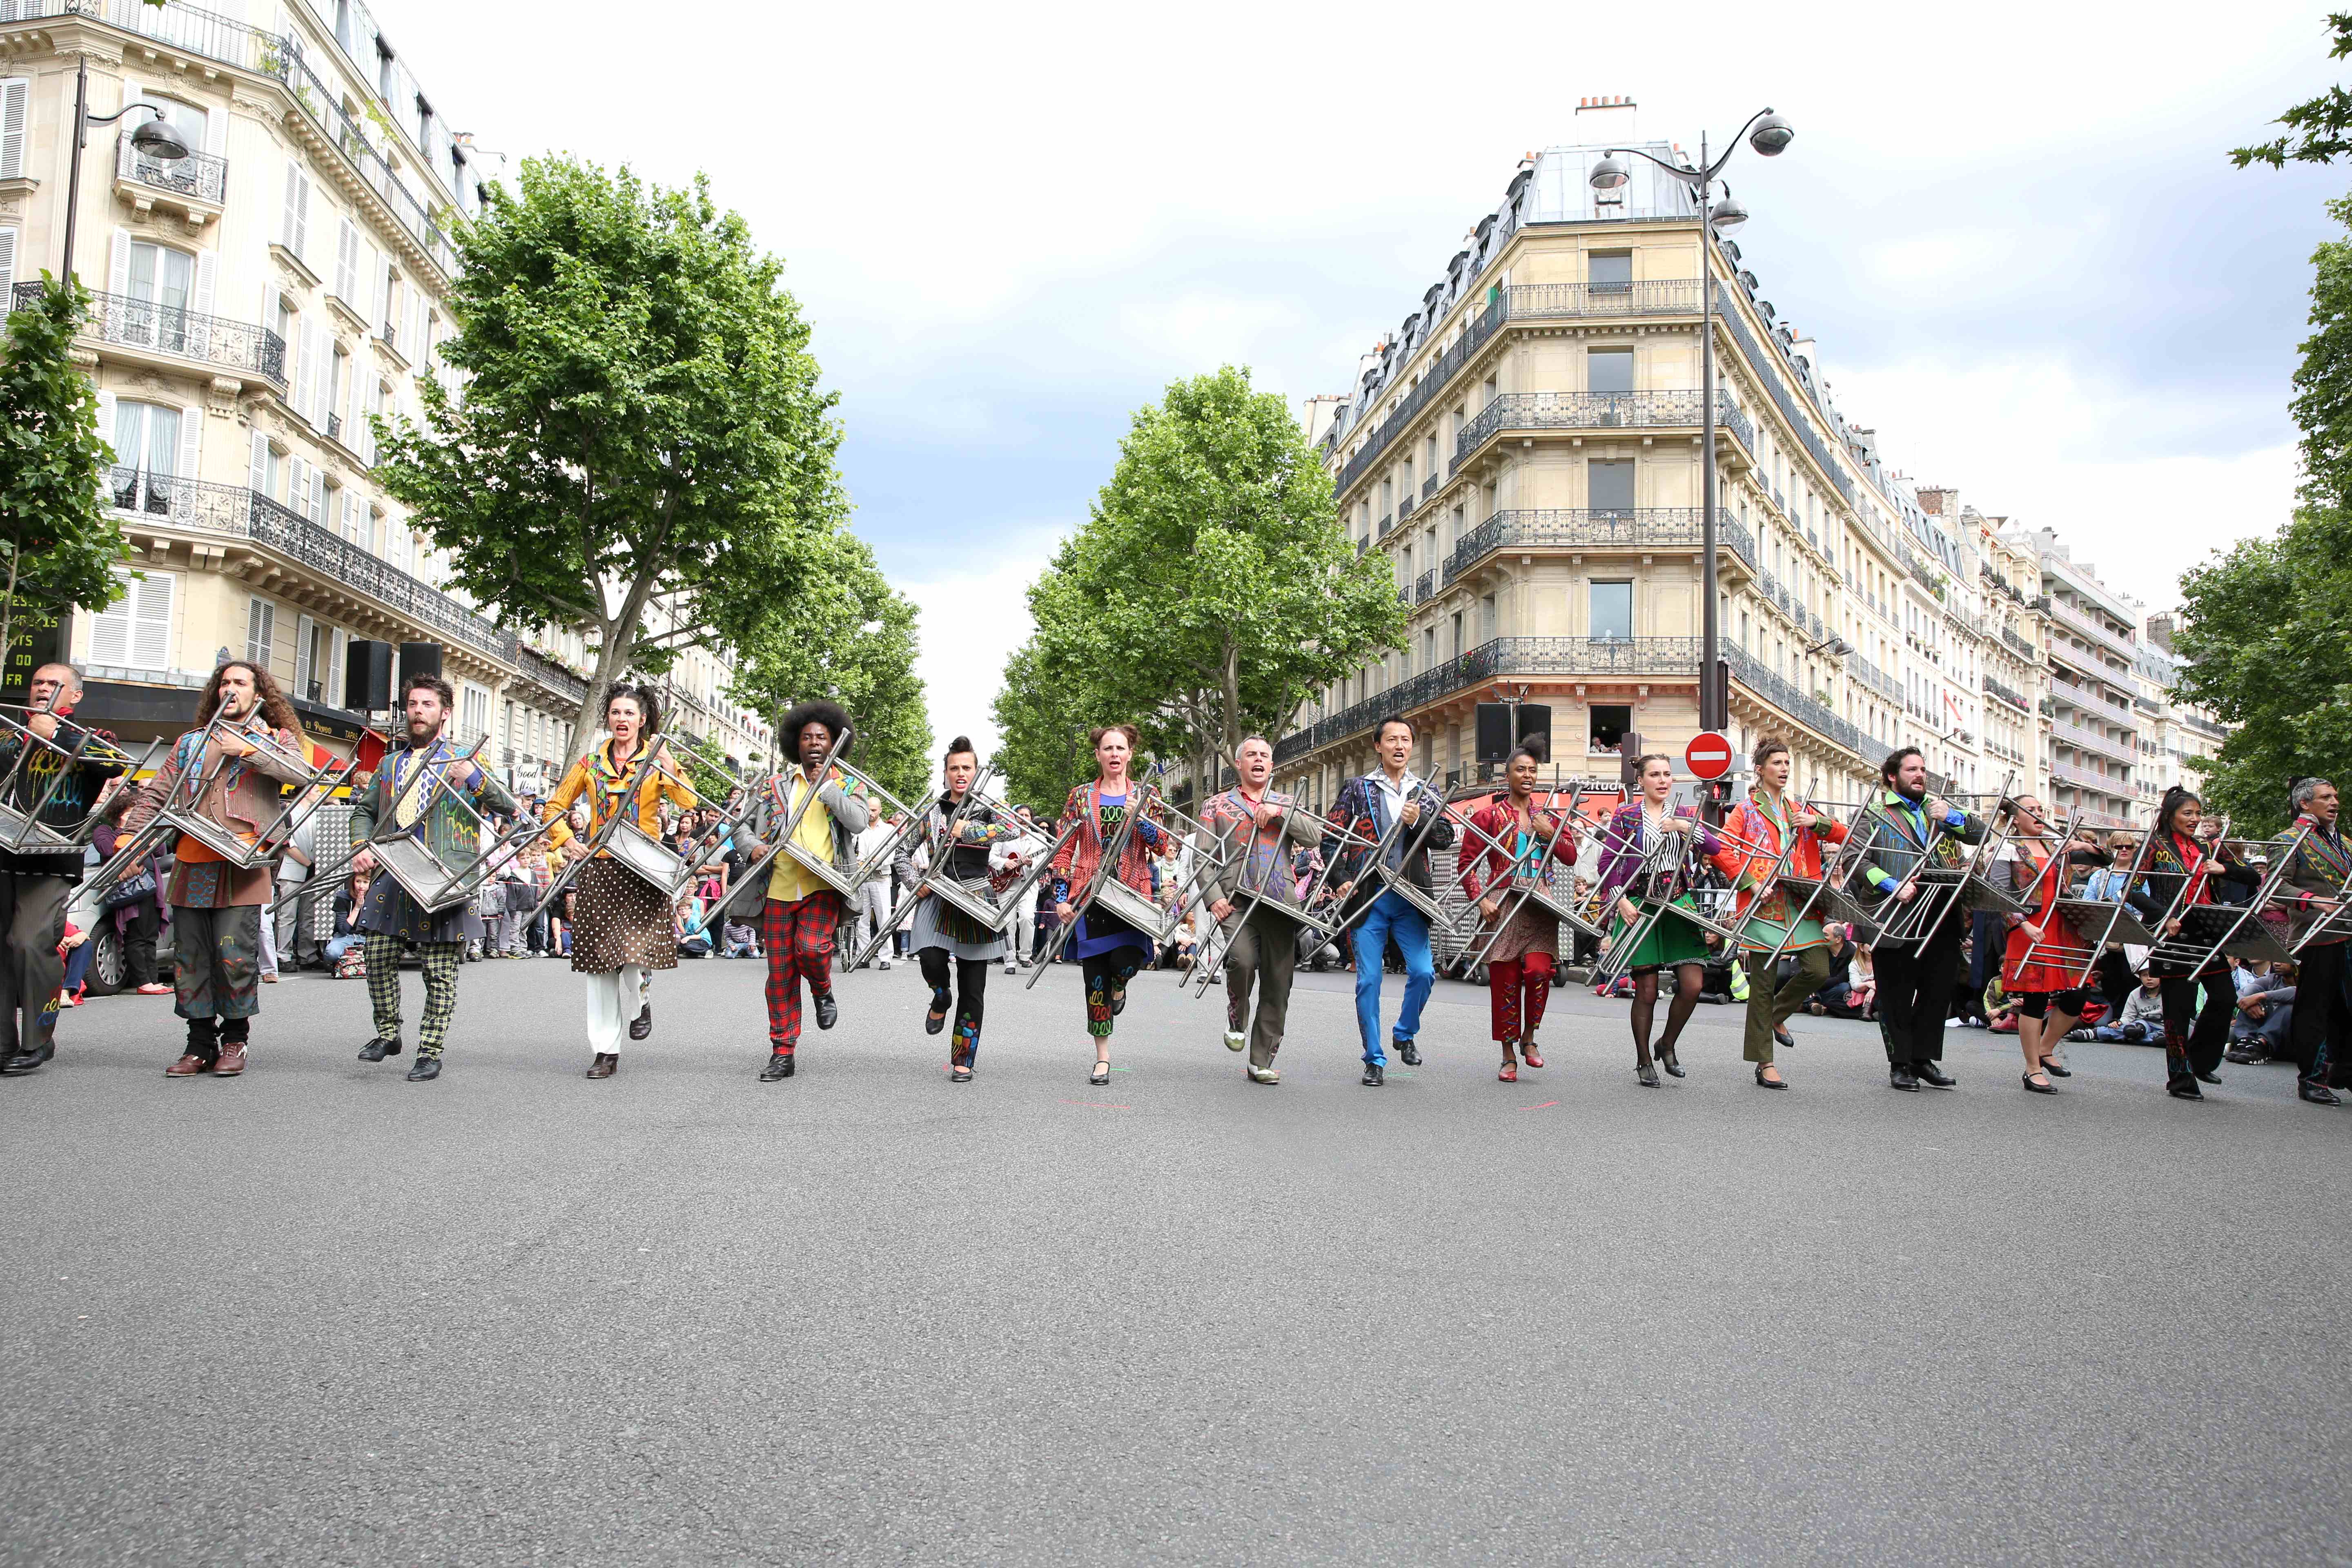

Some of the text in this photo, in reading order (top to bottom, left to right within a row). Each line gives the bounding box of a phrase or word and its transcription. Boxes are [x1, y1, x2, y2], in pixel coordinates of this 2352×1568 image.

[7, 674, 22, 686] FR
[345, 730, 358, 740] TAPAS
[516, 765, 539, 778] Good
